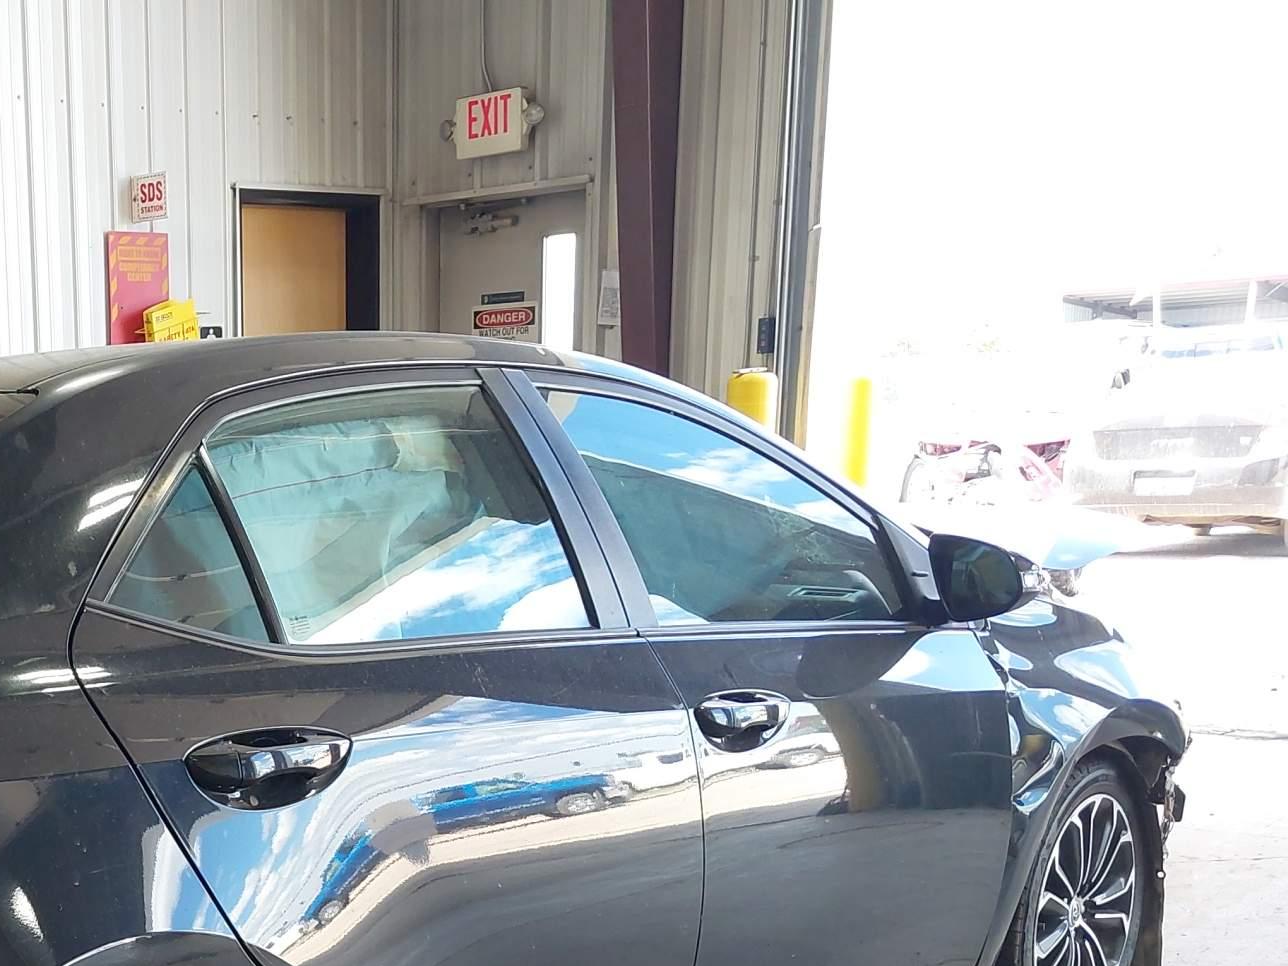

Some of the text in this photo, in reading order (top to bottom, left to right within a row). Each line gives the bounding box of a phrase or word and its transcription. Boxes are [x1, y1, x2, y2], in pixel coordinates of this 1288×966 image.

[468, 93, 512, 140] EXIT
[139, 180, 163, 204] SDS
[140, 204, 164, 214] STATION
[482, 311, 526, 325] DANGER
[478, 326, 529, 337] WATCH OUT FOR
